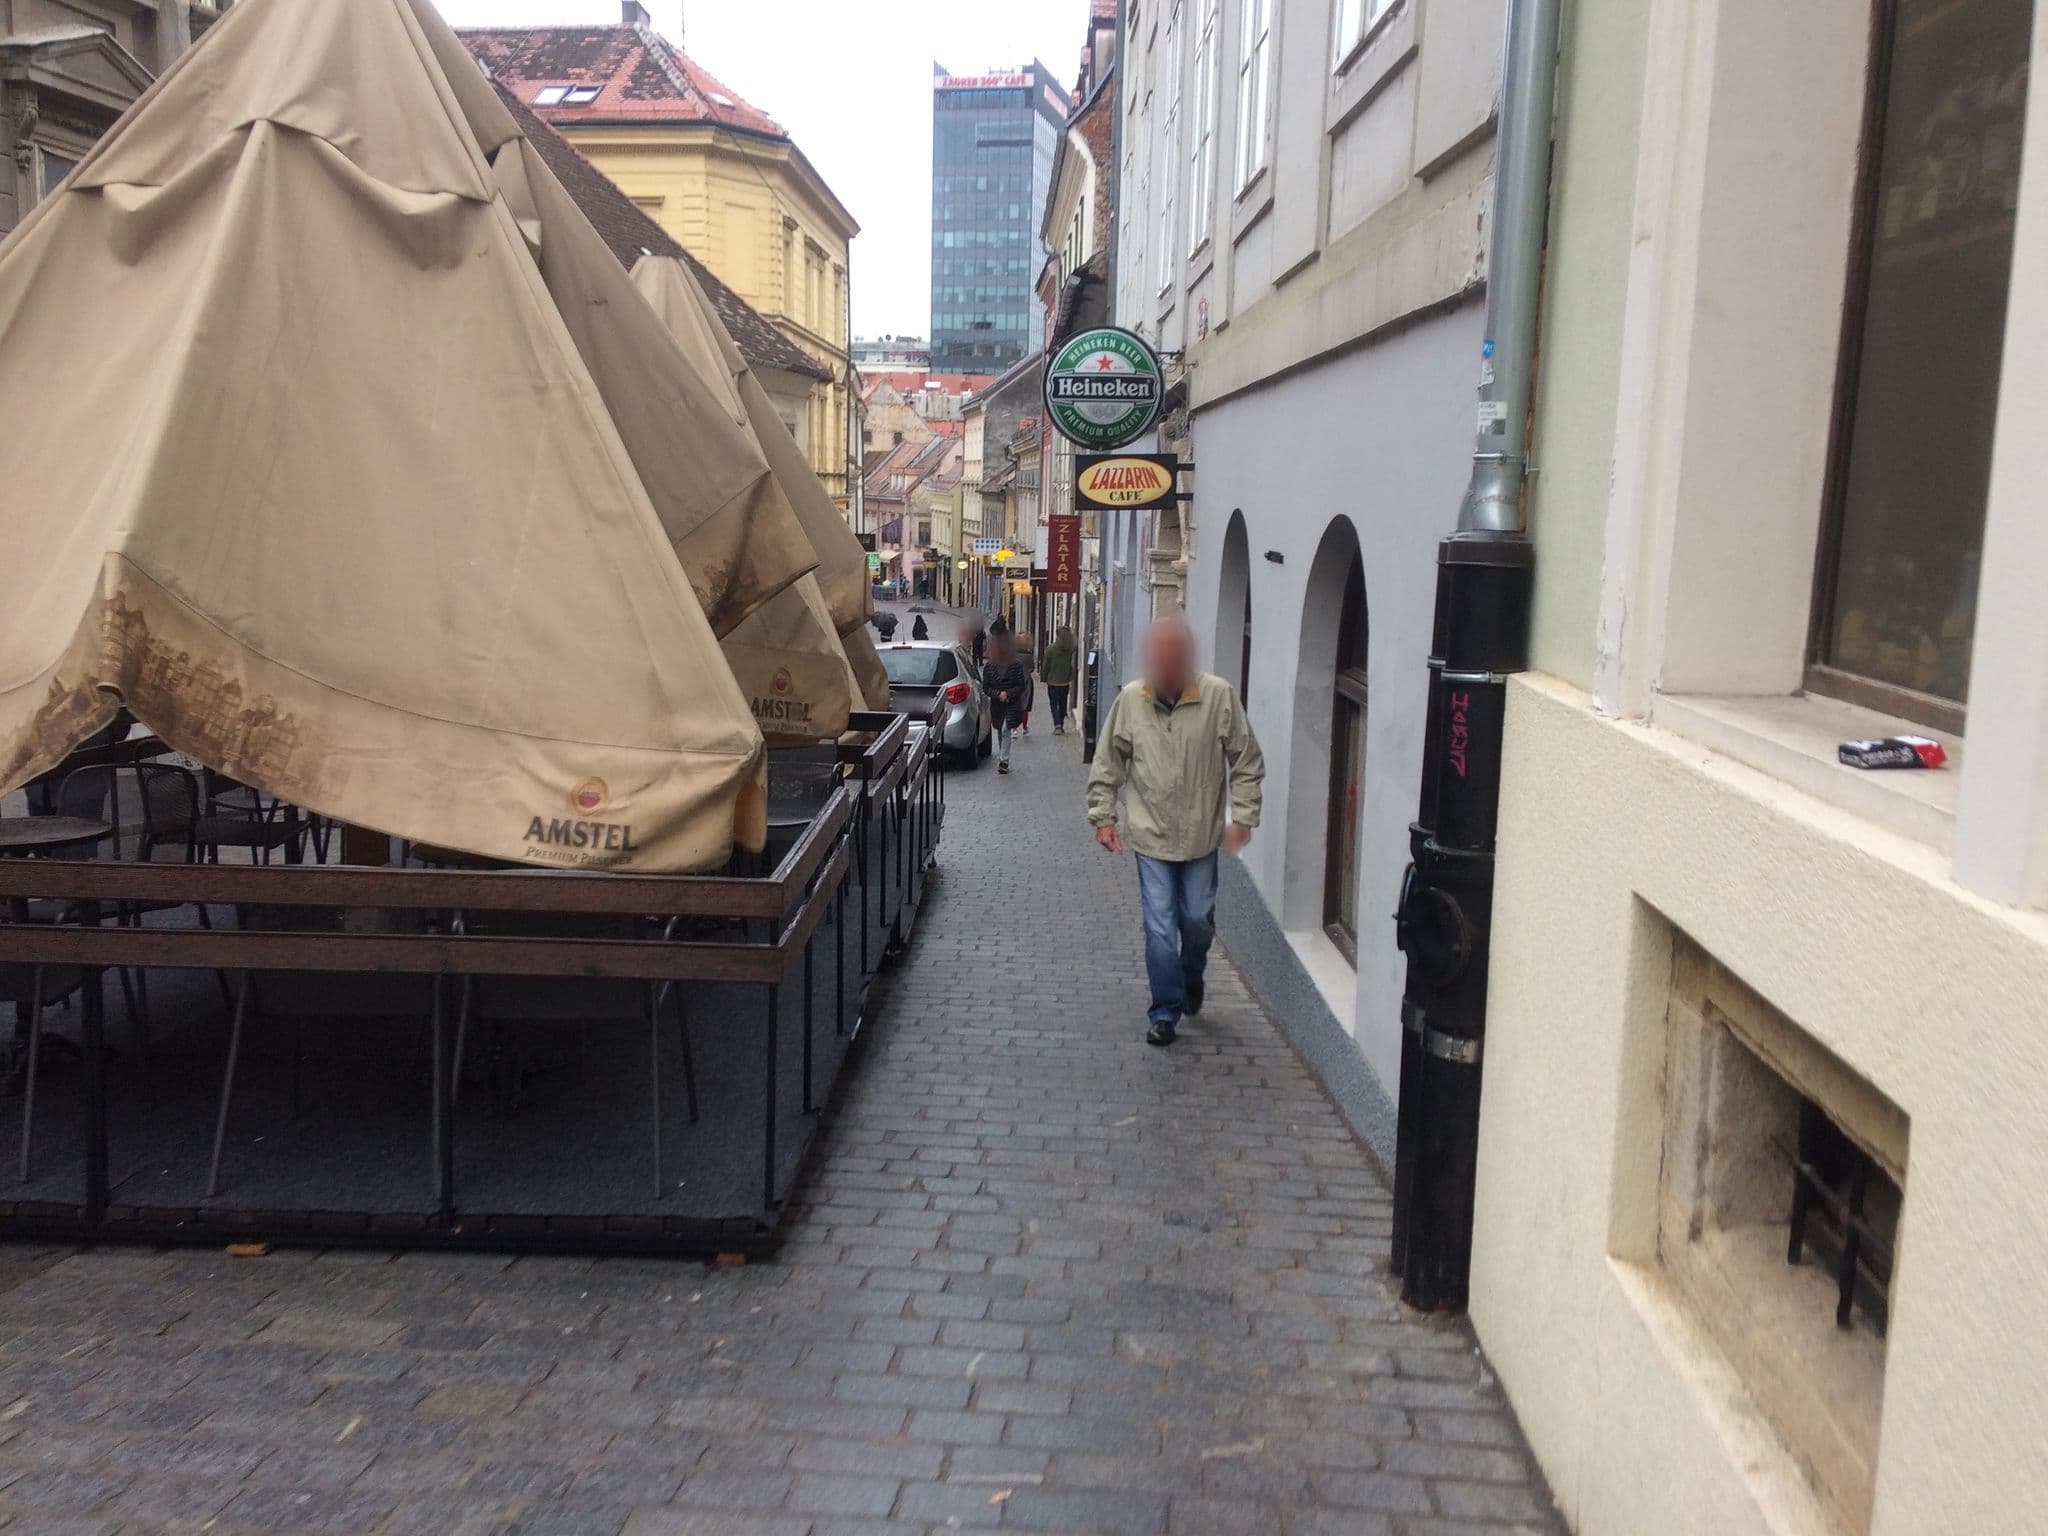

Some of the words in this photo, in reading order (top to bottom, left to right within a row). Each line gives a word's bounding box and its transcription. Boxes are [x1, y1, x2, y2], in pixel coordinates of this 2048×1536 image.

[943, 77, 977, 87] ZAGREB
[1068, 338, 1116, 361] HEINEKEN
[1120, 344, 1142, 364] BEER
[1058, 378, 1150, 397] Heineken
[1063, 409, 1103, 436] PREMIUM
[1108, 409, 1143, 436] QUALITY
[1089, 467, 1161, 490] LAZZARIN
[1057, 524, 1070, 582] ZLATAR
[522, 815, 639, 851] AMSTEL
[525, 846, 578, 864] PREMIUM
